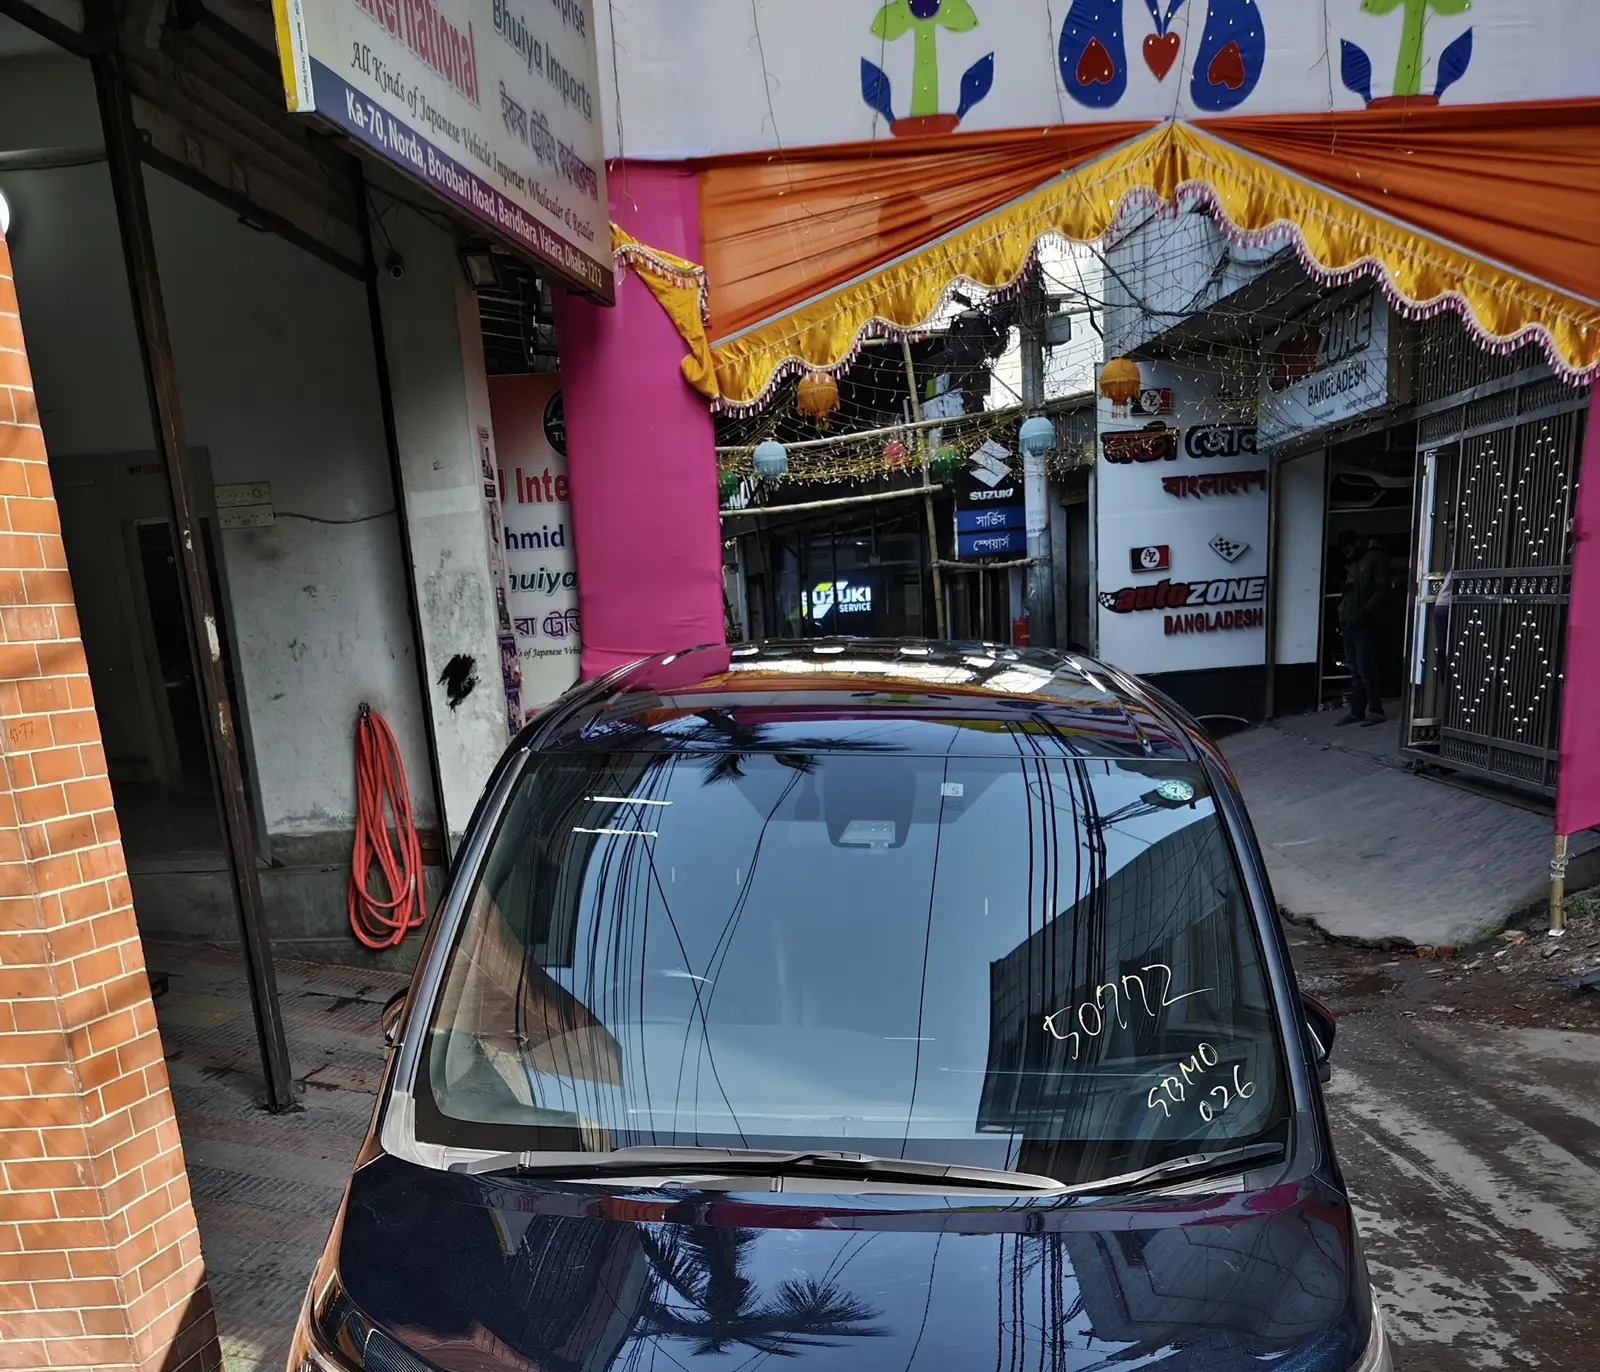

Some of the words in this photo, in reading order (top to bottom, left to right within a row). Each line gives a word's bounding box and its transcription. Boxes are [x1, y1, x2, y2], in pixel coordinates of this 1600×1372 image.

[545, 42, 592, 117] Imports
[350, 41, 372, 76] All
[372, 56, 405, 102] Kinds
[407, 85, 419, 119] of
[420, 94, 460, 144] Japanese
[461, 126, 491, 168] Vehicle
[527, 177, 564, 220] Wholesaler
[345, 87, 388, 148] Ka-70,
[388, 118, 427, 175] Norda,
[427, 147, 472, 202] Borobari
[472, 178, 498, 223] Road,
[498, 196, 539, 250] Baridhara,
[538, 226, 565, 267] Vatara,
[564, 244, 603, 289] Dhaka-1212
[1307, 360, 1367, 407] BANGLADESH
[969, 487, 1014, 501] SUZUKI
[839, 602, 872, 613] SERVICE
[1163, 607, 1264, 637] BANGLADESH
[532, 648, 562, 659] Japanese
